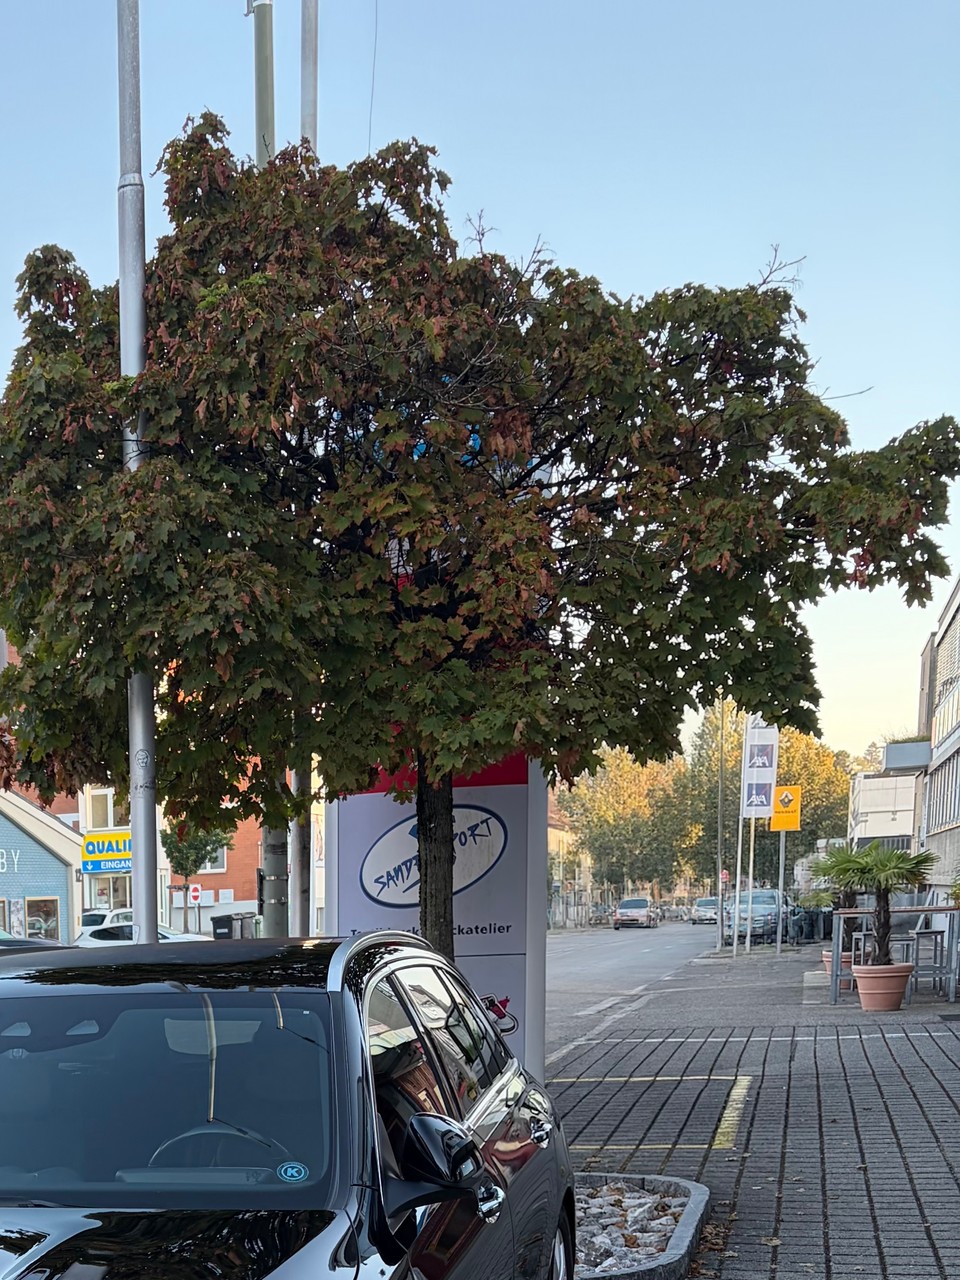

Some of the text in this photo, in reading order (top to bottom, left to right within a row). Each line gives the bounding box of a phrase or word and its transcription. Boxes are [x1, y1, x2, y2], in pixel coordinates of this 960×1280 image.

[748, 756, 769, 767] AXA
[746, 794, 767, 805] AXA
[101, 860, 132, 869] EINGAN
[453, 923, 512, 935] ckatelier
